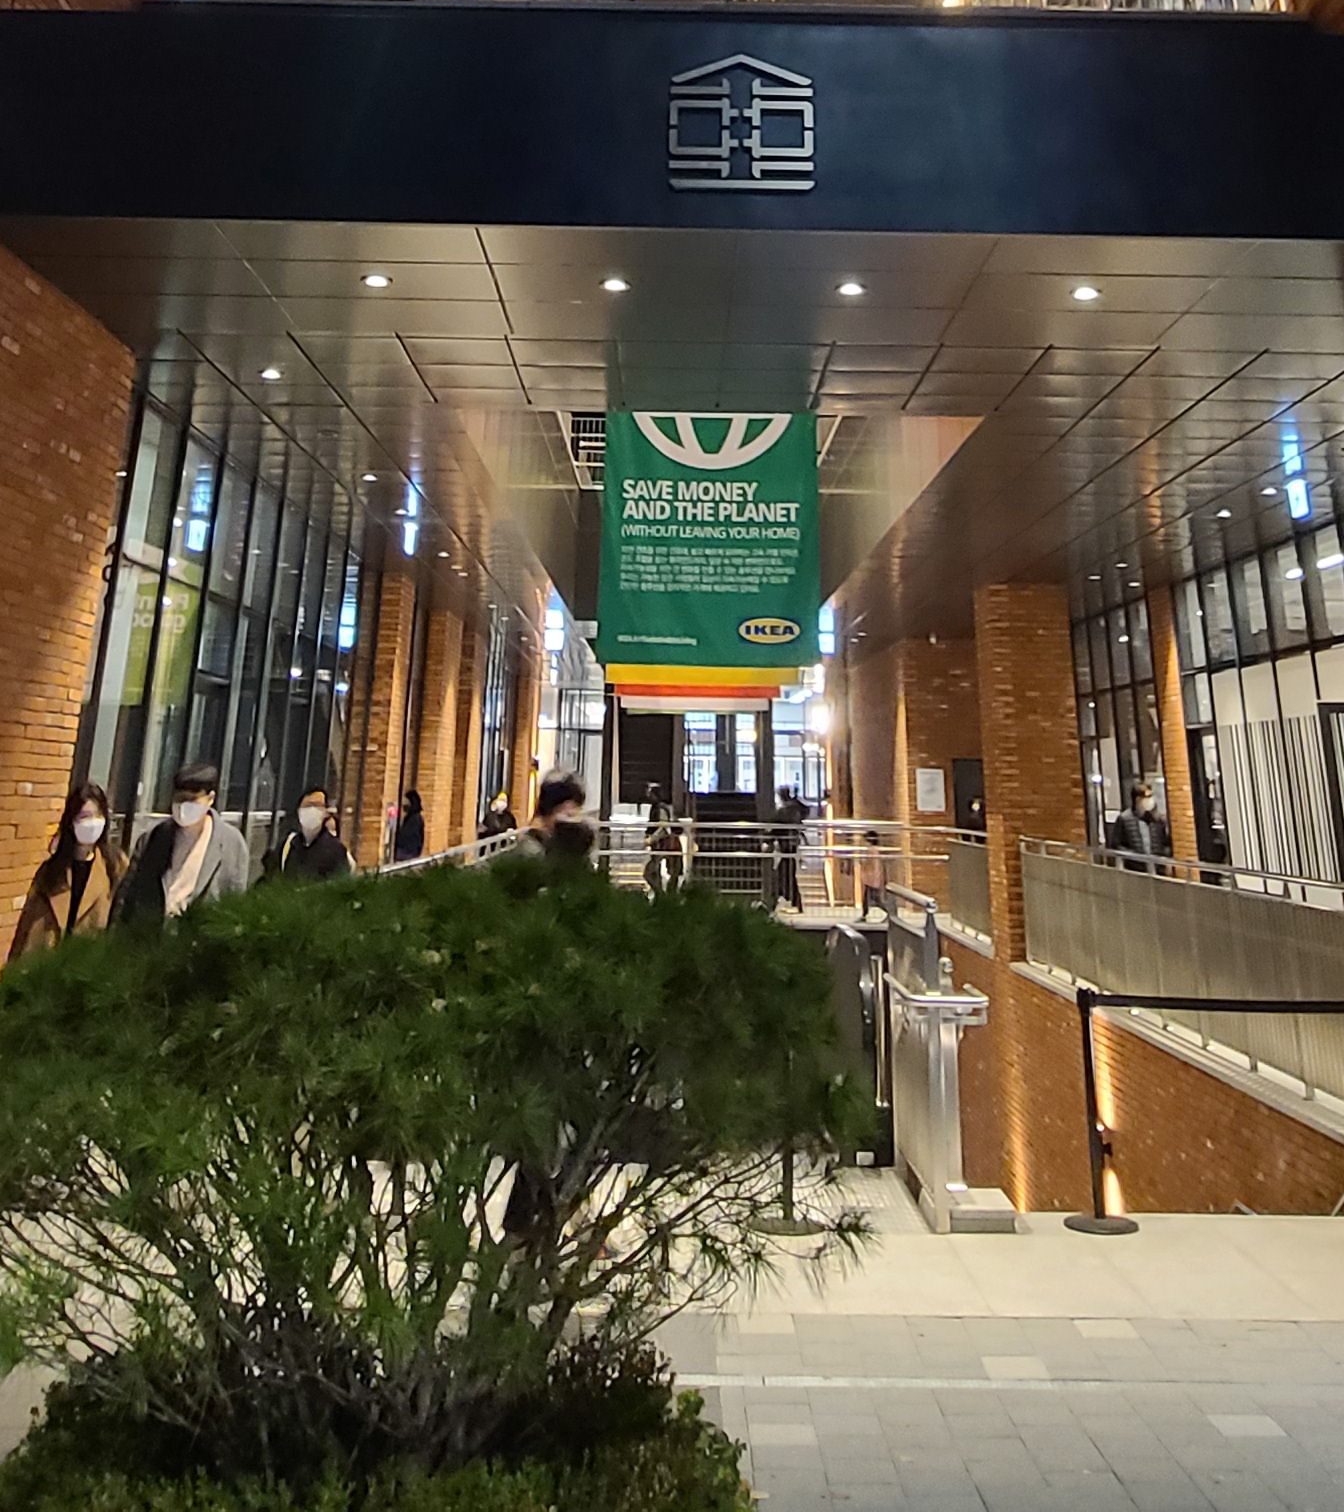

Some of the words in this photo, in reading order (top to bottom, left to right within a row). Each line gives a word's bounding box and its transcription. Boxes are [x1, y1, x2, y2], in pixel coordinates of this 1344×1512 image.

[622, 479, 673, 500] SAVE
[677, 481, 758, 502] MONEY
[622, 500, 671, 520] AND
[674, 501, 715, 521] THE
[719, 502, 800, 523] PLANET
[621, 524, 678, 538] (WITHOUT
[679, 525, 726, 538] LEAVING
[728, 527, 760, 539] YOUR
[763, 527, 800, 540] HOME)
[744, 625, 795, 636] IKEA
